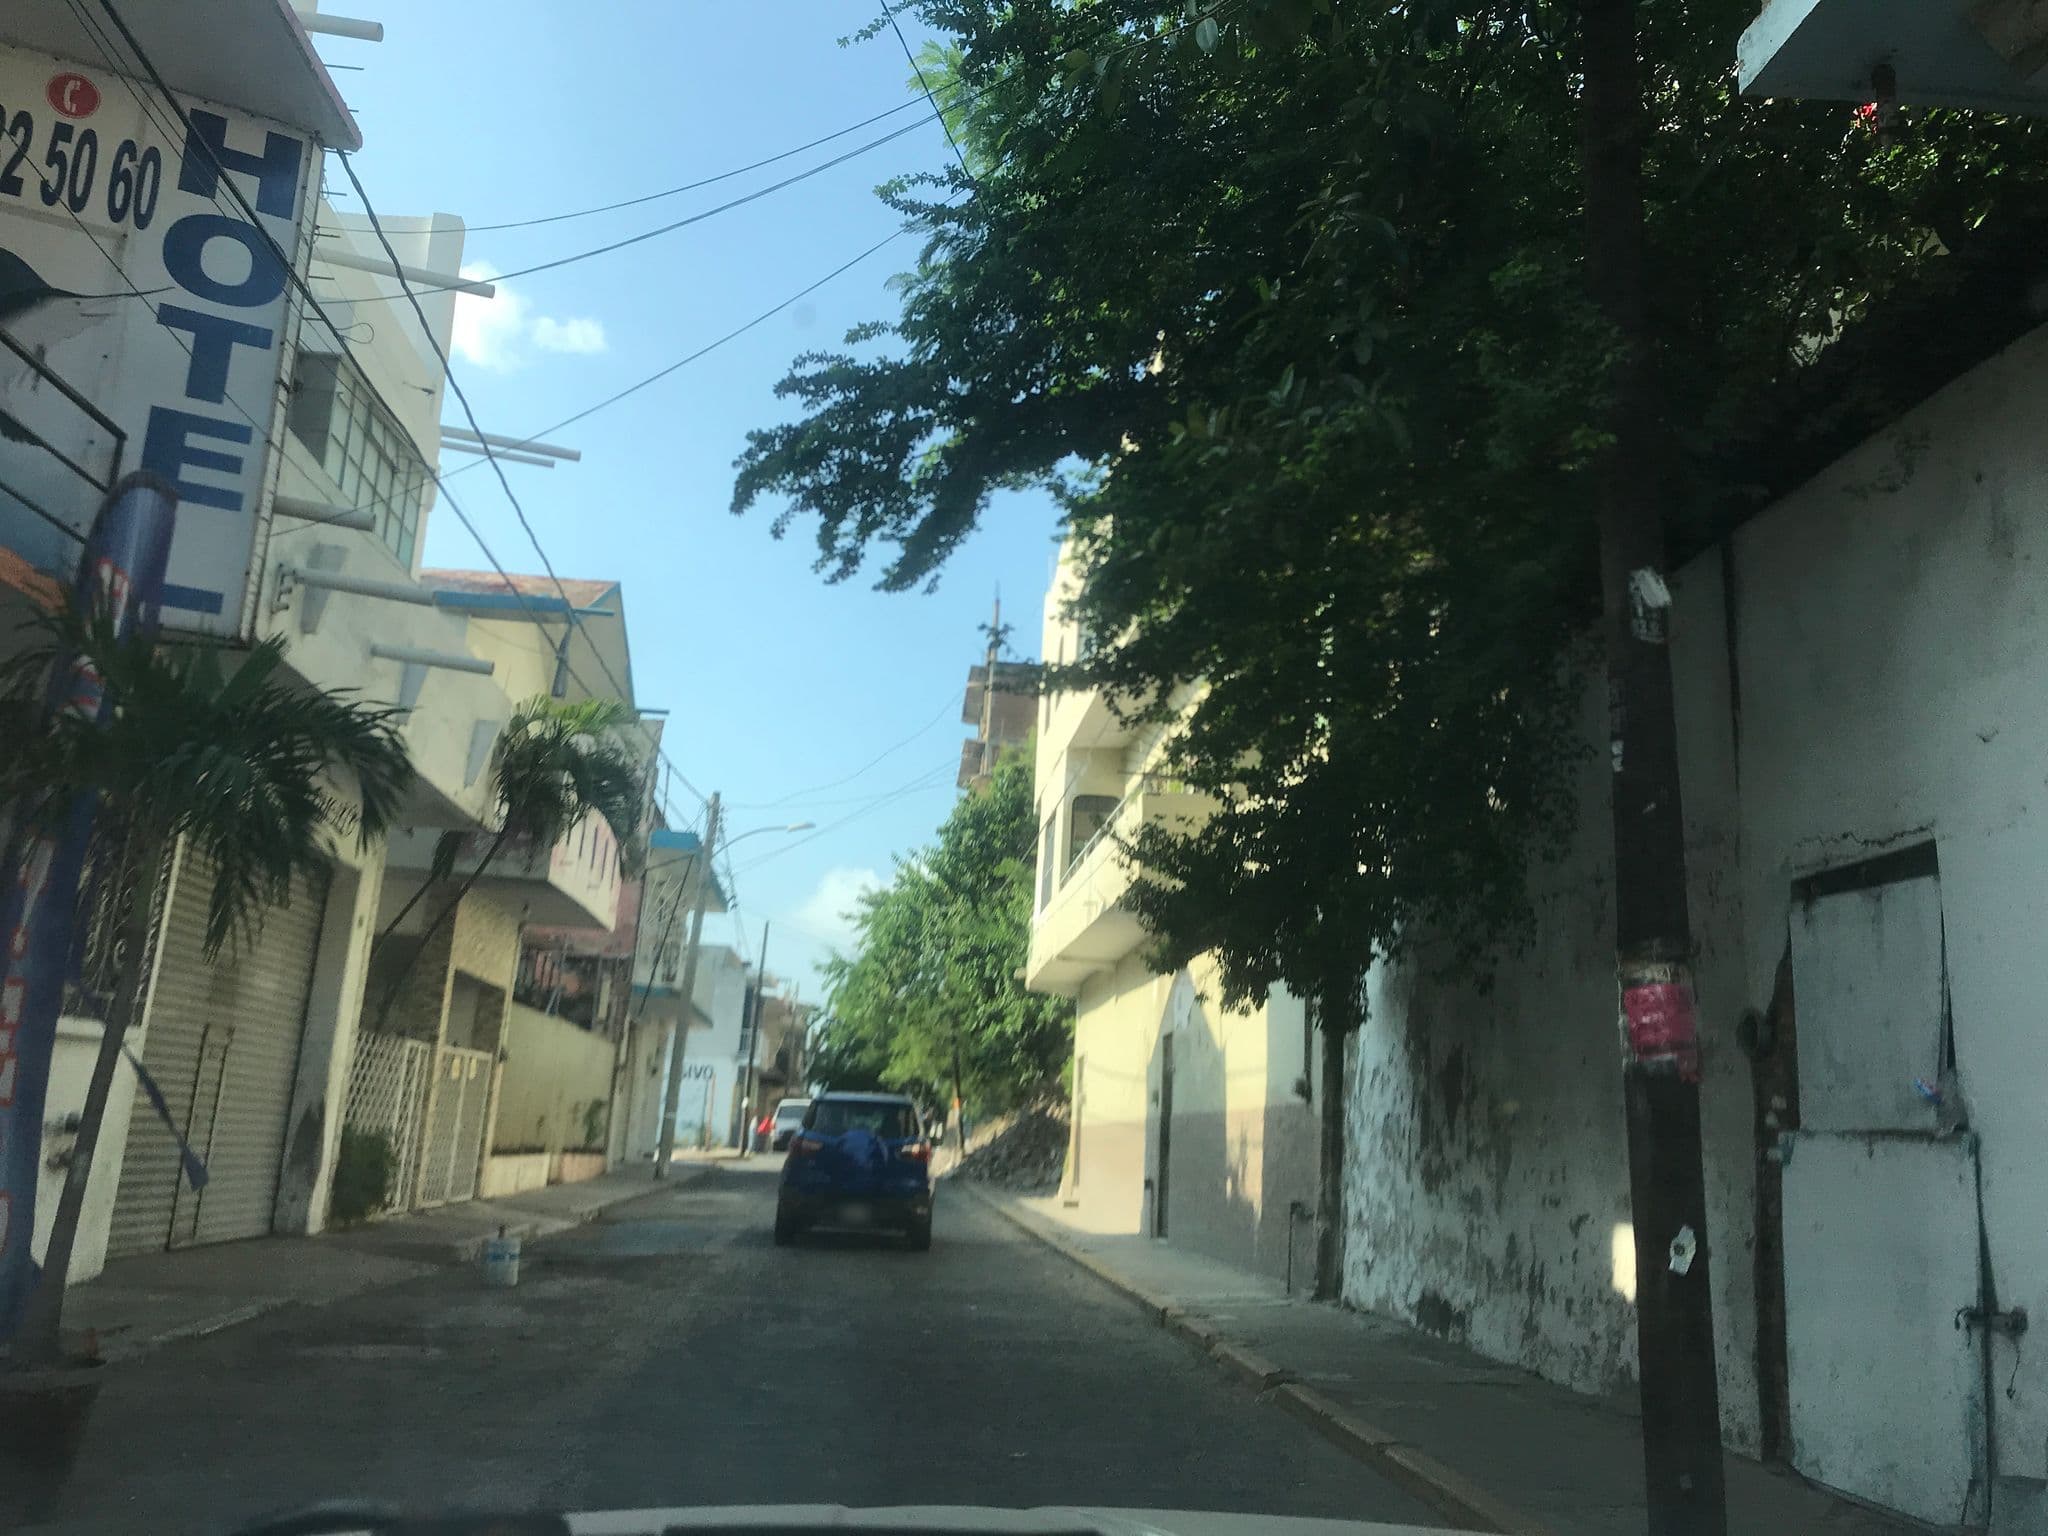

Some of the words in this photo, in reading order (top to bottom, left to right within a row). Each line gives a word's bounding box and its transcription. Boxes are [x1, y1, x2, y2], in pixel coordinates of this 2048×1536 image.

[0, 104, 34, 197] 2
[40, 121, 98, 213] 50
[107, 139, 162, 231] 60
[682, 1063, 714, 1081] IVO
